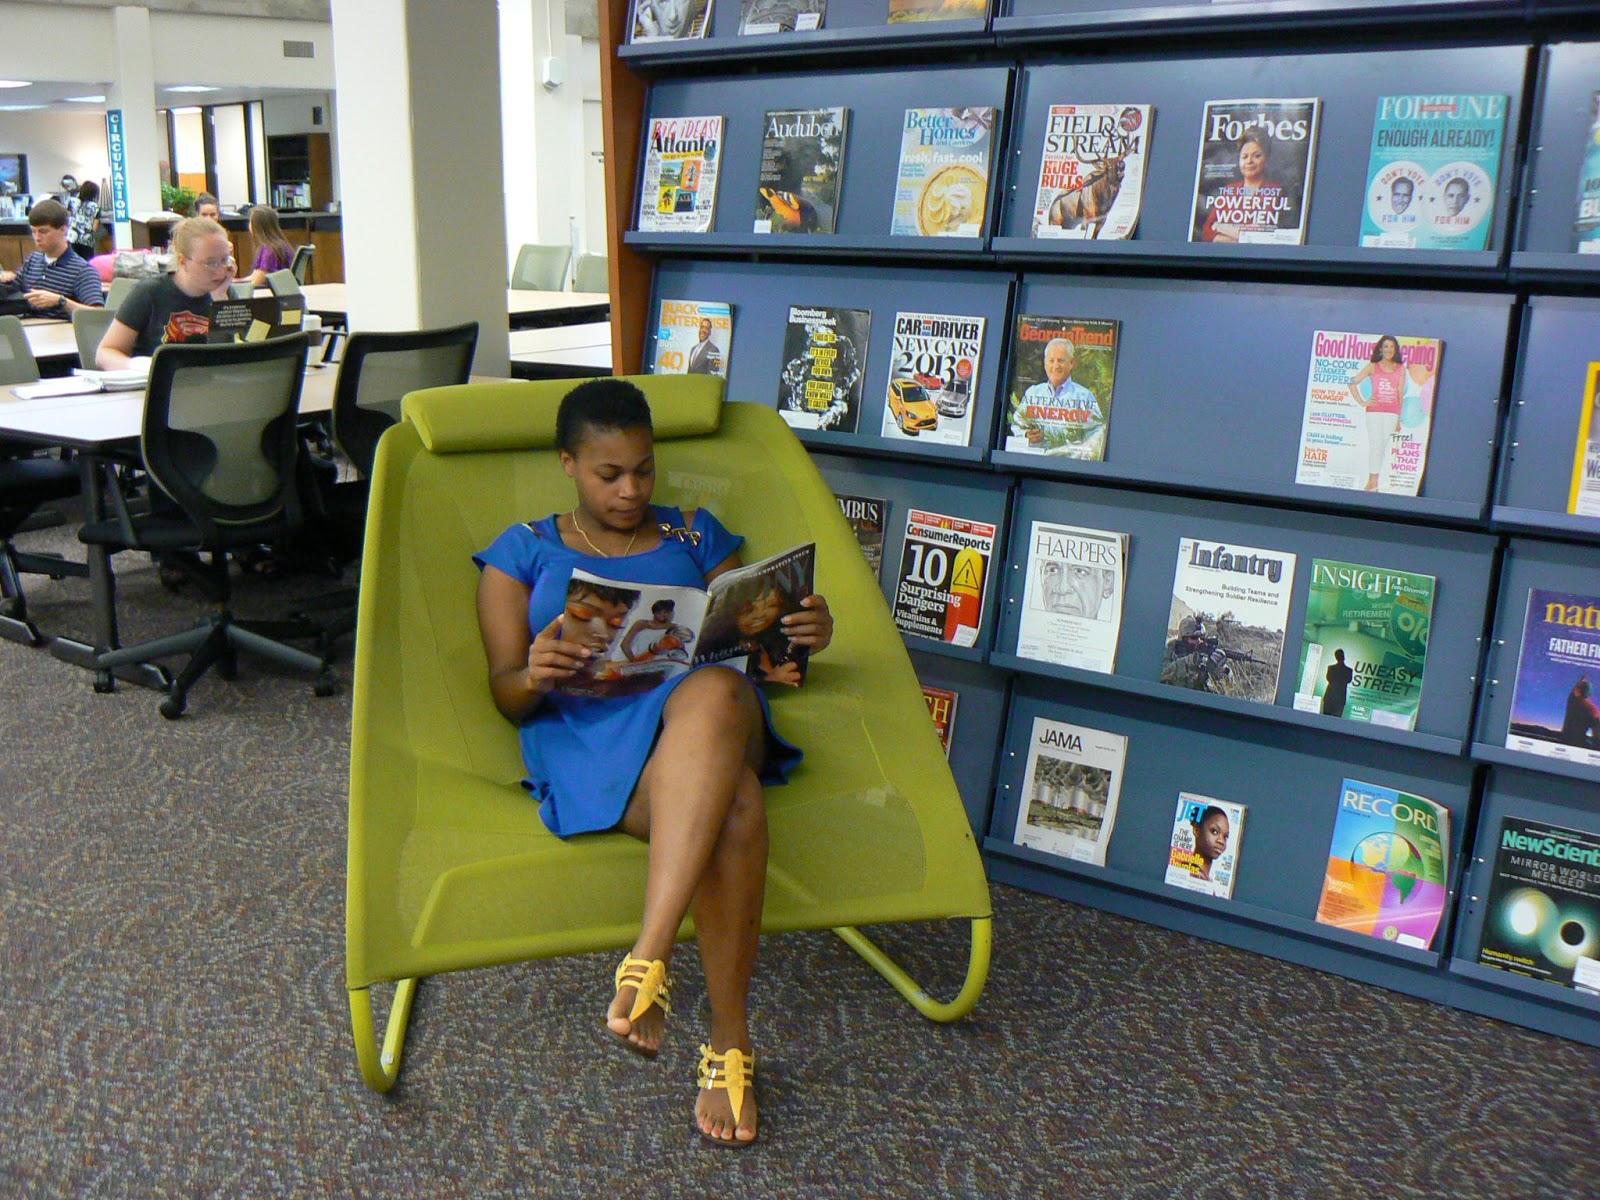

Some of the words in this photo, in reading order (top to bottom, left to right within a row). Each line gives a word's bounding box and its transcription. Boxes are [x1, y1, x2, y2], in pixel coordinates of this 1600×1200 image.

[1381, 96, 1506, 120] FORTUNE
[764, 115, 839, 138] Audubon
[906, 111, 952, 129] Better
[1049, 115, 1114, 134] FIELD
[1209, 113, 1307, 141] Forbes
[650, 132, 716, 154] Atlanta
[920, 127, 976, 146] Homes
[1045, 135, 1141, 154] STREAM
[1377, 129, 1429, 148] ENOUGH
[1430, 130, 1495, 148] ALREADY!
[110, 113, 126, 219] CIRCULATION
[960, 151, 983, 163] cool
[1043, 161, 1079, 175] HUGE
[1041, 175, 1084, 190] BULLS
[1408, 169, 1425, 186] VOTE
[1463, 170, 1482, 186] VOTE
[1219, 187, 1234, 195] THE
[1256, 187, 1281, 196] MOST
[1206, 196, 1291, 211] POWERFUL
[1216, 209, 1278, 225] WOMEN
[1382, 214, 1399, 223] FOR
[1401, 215, 1416, 223] HIM
[1434, 216, 1452, 225] FOR
[1455, 217, 1471, 225] HIM
[662, 301, 699, 315] BLACK
[790, 307, 827, 319] Bloomberg
[896, 318, 922, 336] CAR
[931, 321, 979, 340] DRIVER
[894, 336, 931, 353] NEW
[934, 340, 978, 358] CARS
[1315, 332, 1347, 358] Good
[660, 352, 685, 371] 40
[898, 352, 956, 382] 2013
[1315, 359, 1359, 371] NO-COOK
[1312, 374, 1356, 385] SUPPERS
[1313, 366, 1347, 376] SUMMER
[1020, 395, 1097, 409] ALTERNATIVE
[1311, 394, 1344, 402] YOUNGER
[1025, 405, 1092, 423] ENERGY
[1390, 433, 1413, 443] Free!
[1401, 441, 1421, 450] DIET
[1304, 451, 1328, 461] HAIR
[1391, 448, 1420, 457] PLANS
[1397, 456, 1419, 465] THAT
[1391, 463, 1418, 472] WORK
[1036, 535, 1117, 566] HARPER'S
[908, 544, 948, 587] 10
[1188, 541, 1283, 584] Infantry
[1312, 563, 1409, 597] INSIGHT
[899, 581, 962, 608] Surprising
[1185, 585, 1225, 598] Strengthening
[1225, 592, 1247, 601] Soldier
[1247, 595, 1279, 606] Resilience
[1221, 584, 1246, 594] Building
[1247, 587, 1267, 596] Teams
[898, 592, 945, 613] Dangers
[894, 616, 943, 635] Supplements
[896, 609, 931, 625] Vitamins
[931, 617, 938, 626] &
[1548, 637, 1588, 657] FATHER
[1354, 661, 1420, 684] UNEASY
[1351, 674, 1414, 697] STREET
[1039, 729, 1082, 752] JAMA
[1177, 800, 1209, 822] JET
[1343, 790, 1439, 834] RECORD
[1171, 848, 1204, 866] Gabrielle
[1510, 855, 1556, 872] MIRROR
[1530, 869, 1586, 888] MERGED
